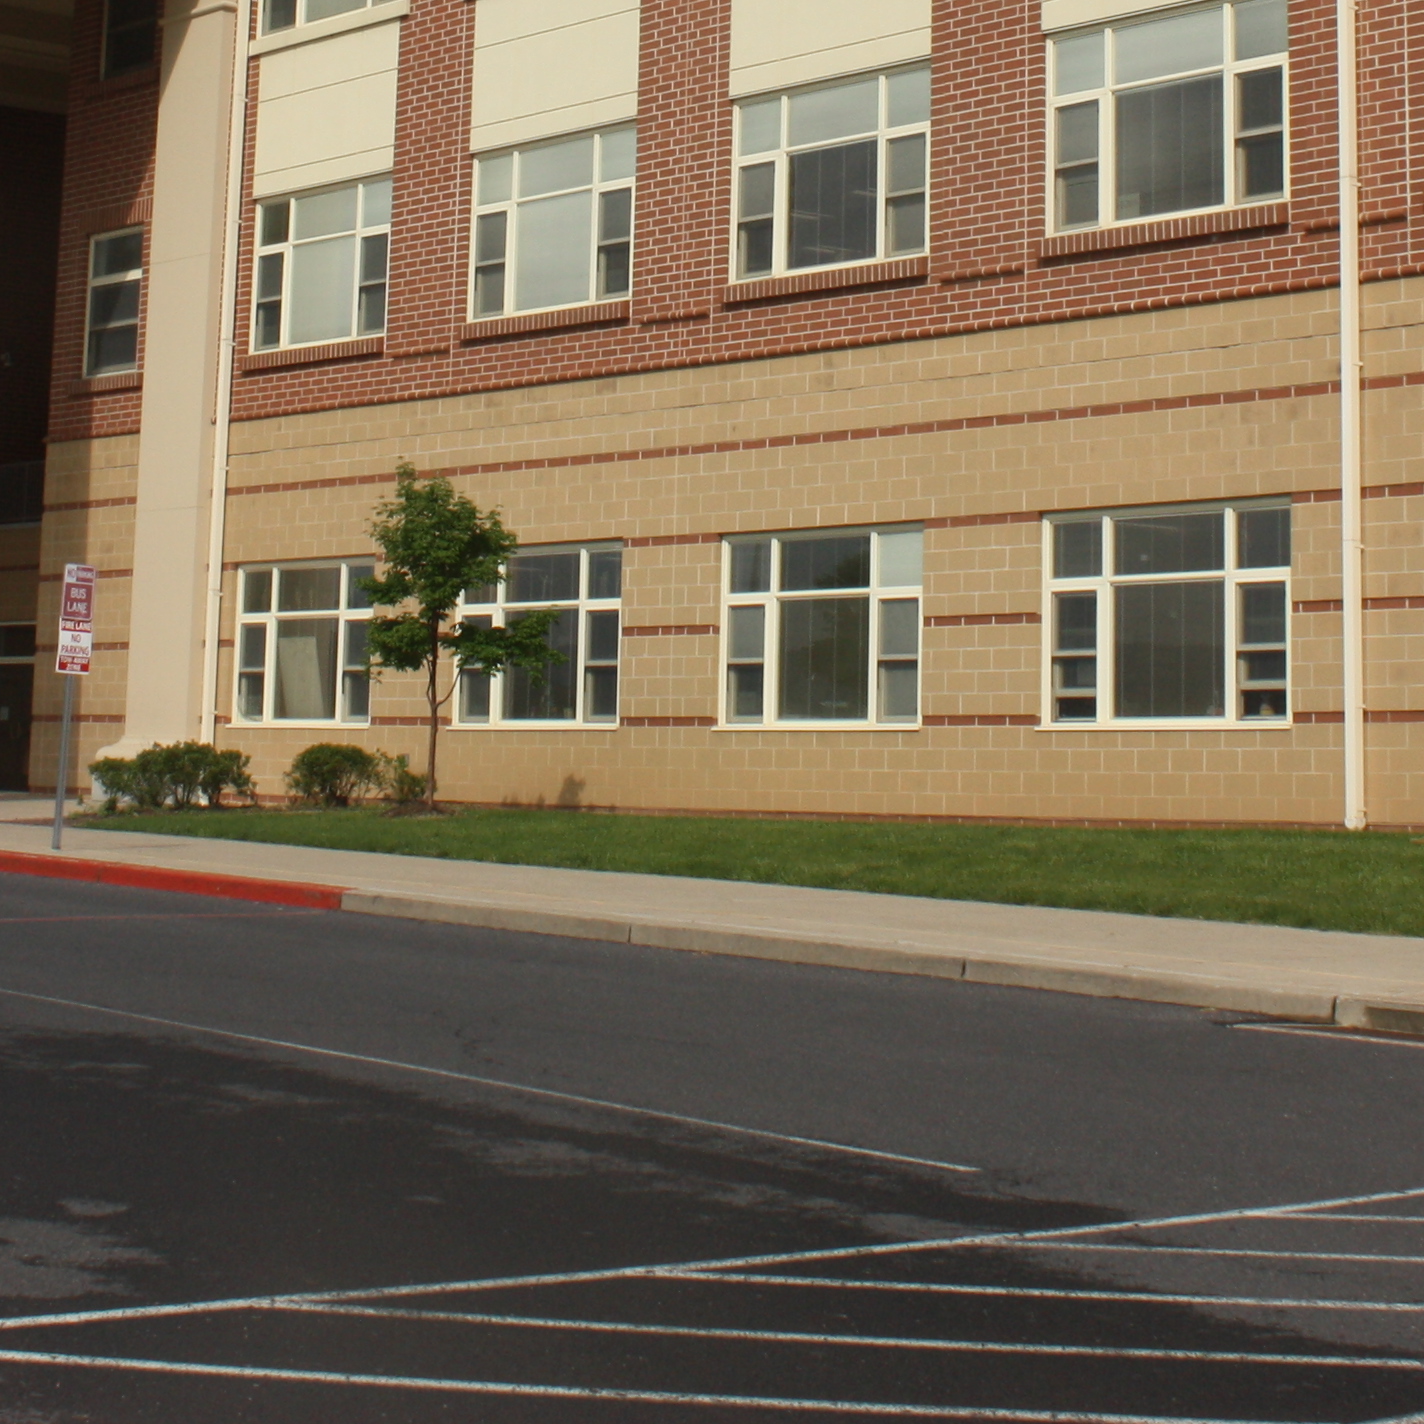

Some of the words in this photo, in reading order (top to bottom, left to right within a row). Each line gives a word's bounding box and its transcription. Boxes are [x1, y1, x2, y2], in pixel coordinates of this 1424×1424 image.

[70, 587, 87, 599] BUS
[67, 601, 88, 613] LANE
[61, 620, 74, 630] FIRE
[75, 621, 92, 631] LANE
[71, 634, 81, 643] NO
[61, 644, 89, 656] PARKING
